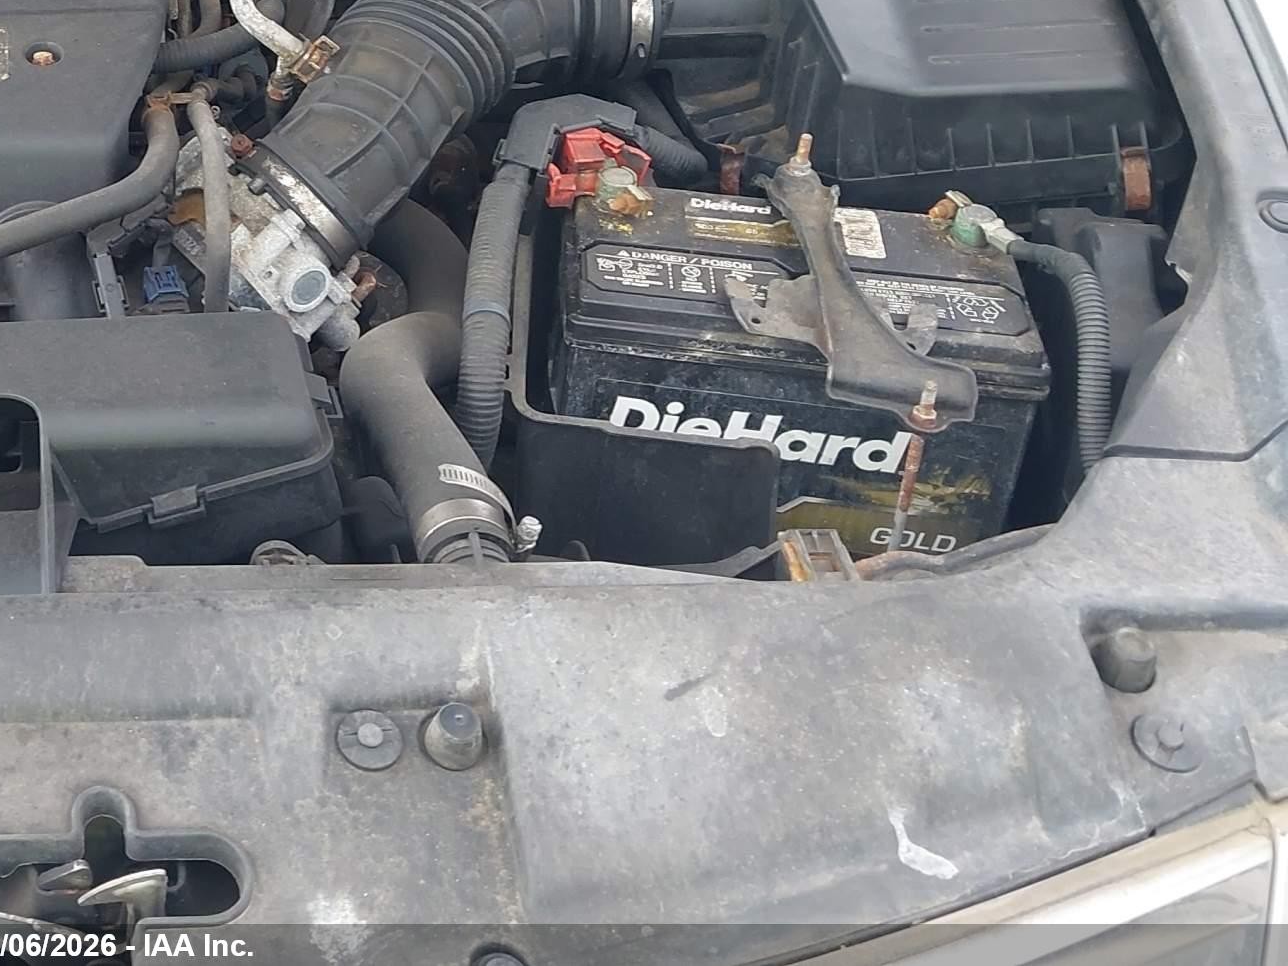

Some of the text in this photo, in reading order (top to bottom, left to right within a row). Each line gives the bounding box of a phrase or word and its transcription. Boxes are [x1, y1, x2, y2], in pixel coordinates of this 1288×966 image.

[689, 197, 772, 215] DieHard
[631, 252, 687, 264] DANGER
[701, 257, 753, 270] POISON
[610, 395, 914, 474] DieHard
[870, 527, 957, 552] GOLD
